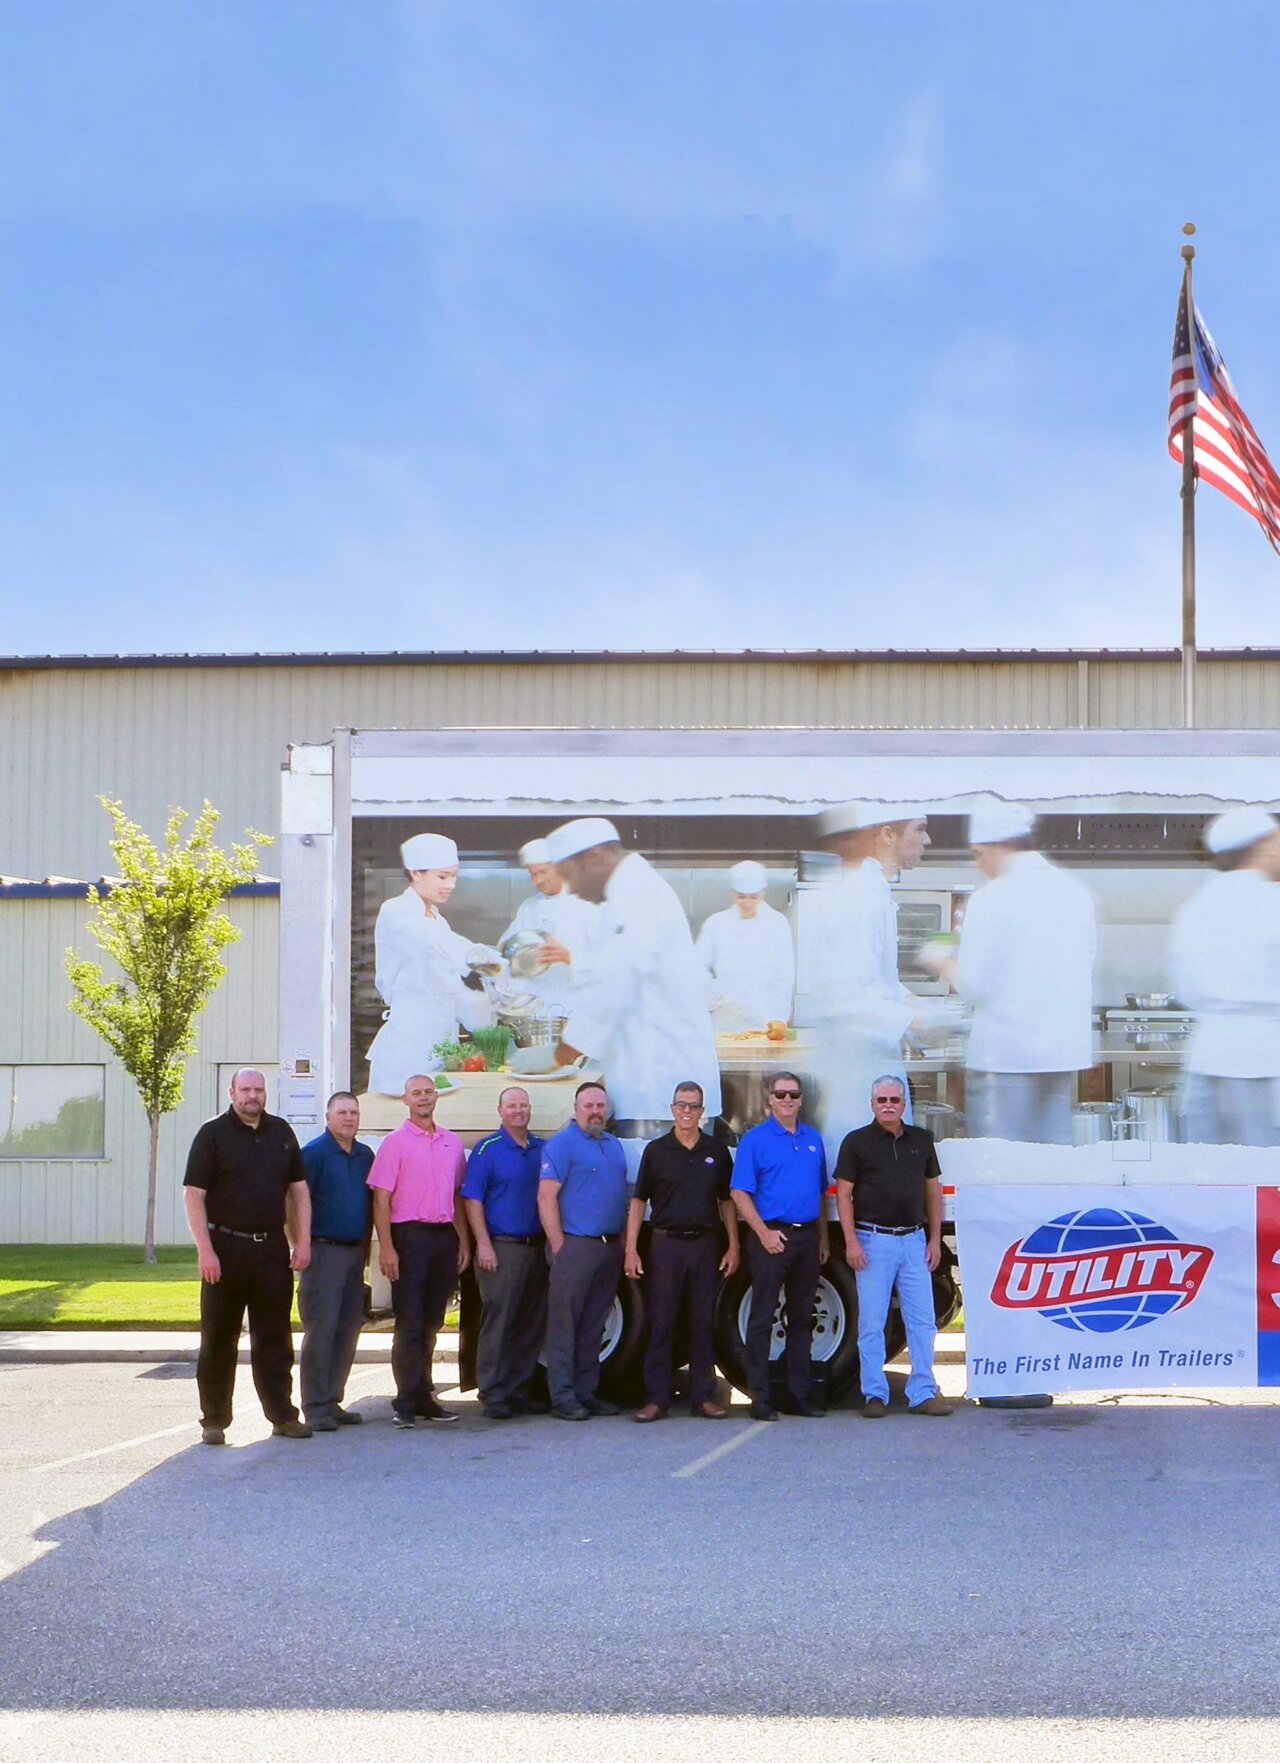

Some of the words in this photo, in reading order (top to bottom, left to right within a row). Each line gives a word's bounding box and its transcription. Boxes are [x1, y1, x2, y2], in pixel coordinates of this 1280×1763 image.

[972, 1358, 1007, 1376] The
[1015, 1354, 1060, 1374] First
[1068, 1352, 1123, 1371] Name
[1132, 1350, 1150, 1368] In
